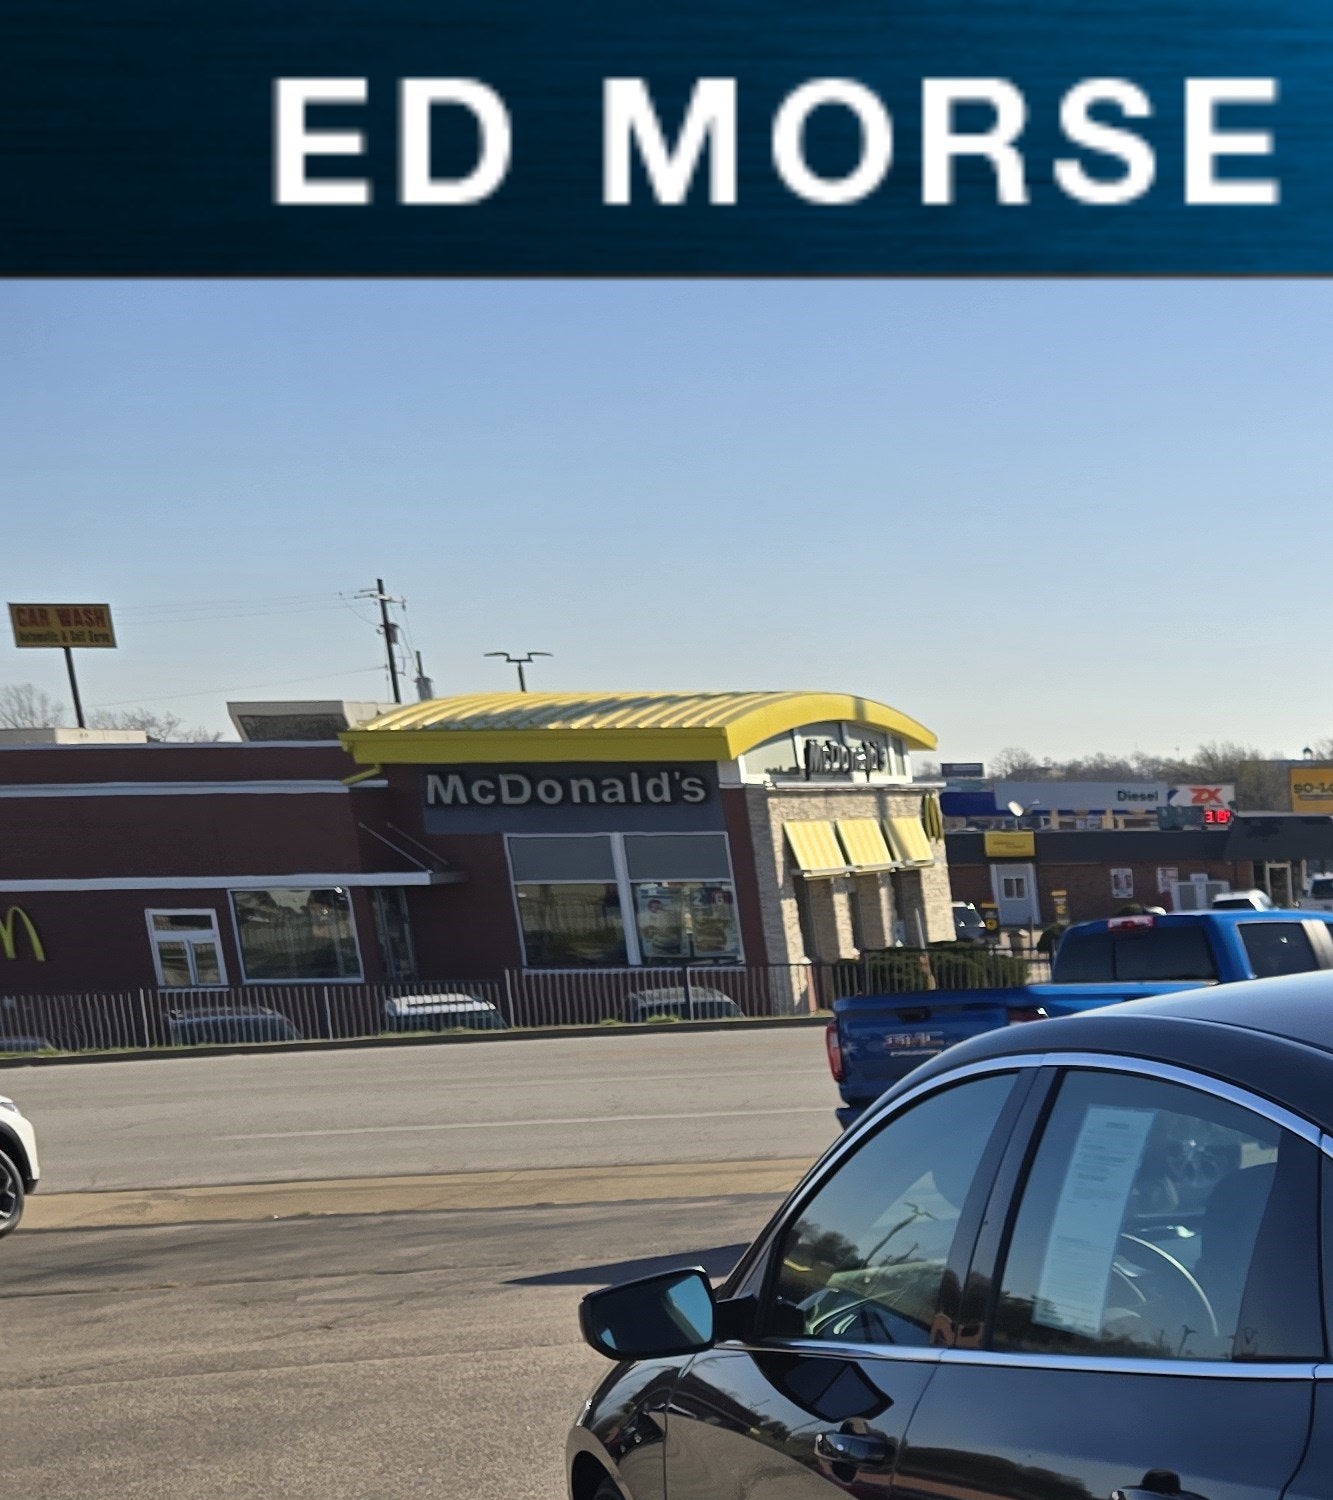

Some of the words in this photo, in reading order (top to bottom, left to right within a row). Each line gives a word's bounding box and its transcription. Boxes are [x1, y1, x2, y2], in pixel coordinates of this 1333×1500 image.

[16, 607, 50, 628] CAR
[56, 607, 108, 628] WASH
[426, 770, 706, 805] McDonald's
[1117, 790, 1159, 802] Diesel
